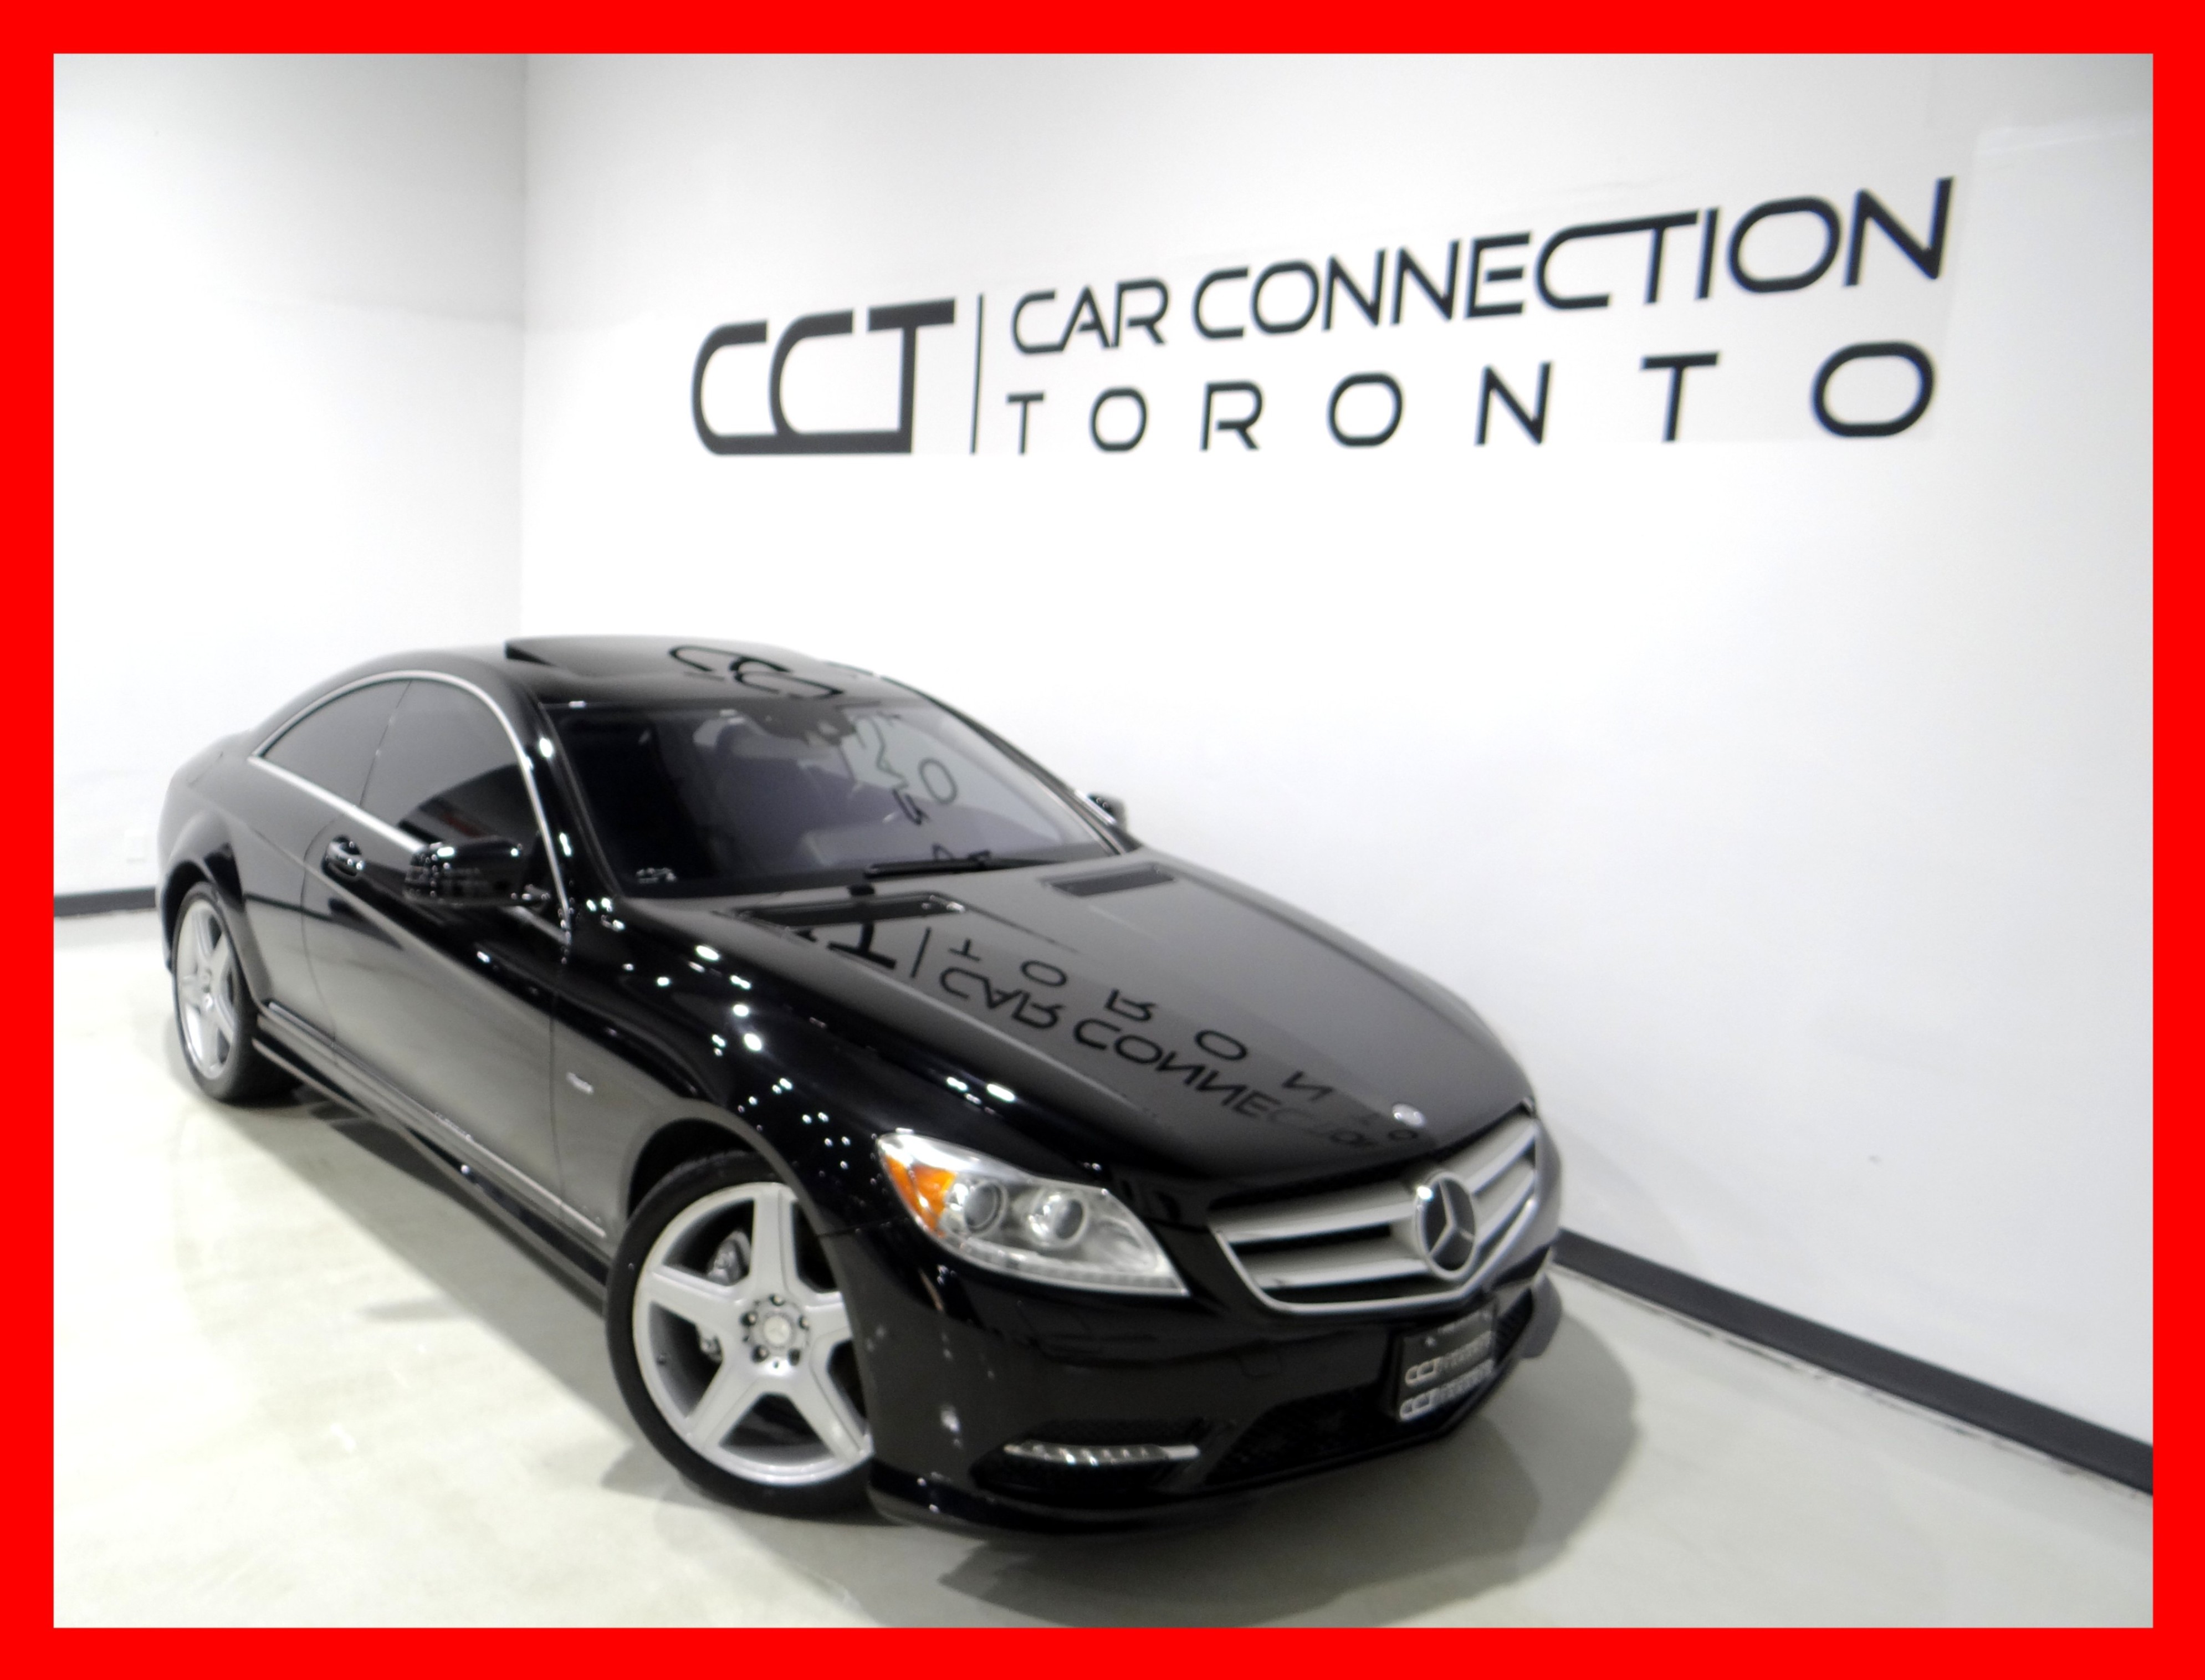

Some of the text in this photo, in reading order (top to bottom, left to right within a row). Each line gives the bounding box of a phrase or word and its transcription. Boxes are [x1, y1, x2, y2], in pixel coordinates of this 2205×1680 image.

[1012, 177, 1955, 355] CAR CONNECTION
[692, 298, 955, 455] CCT
[1007, 341, 1936, 454] TORONTO
